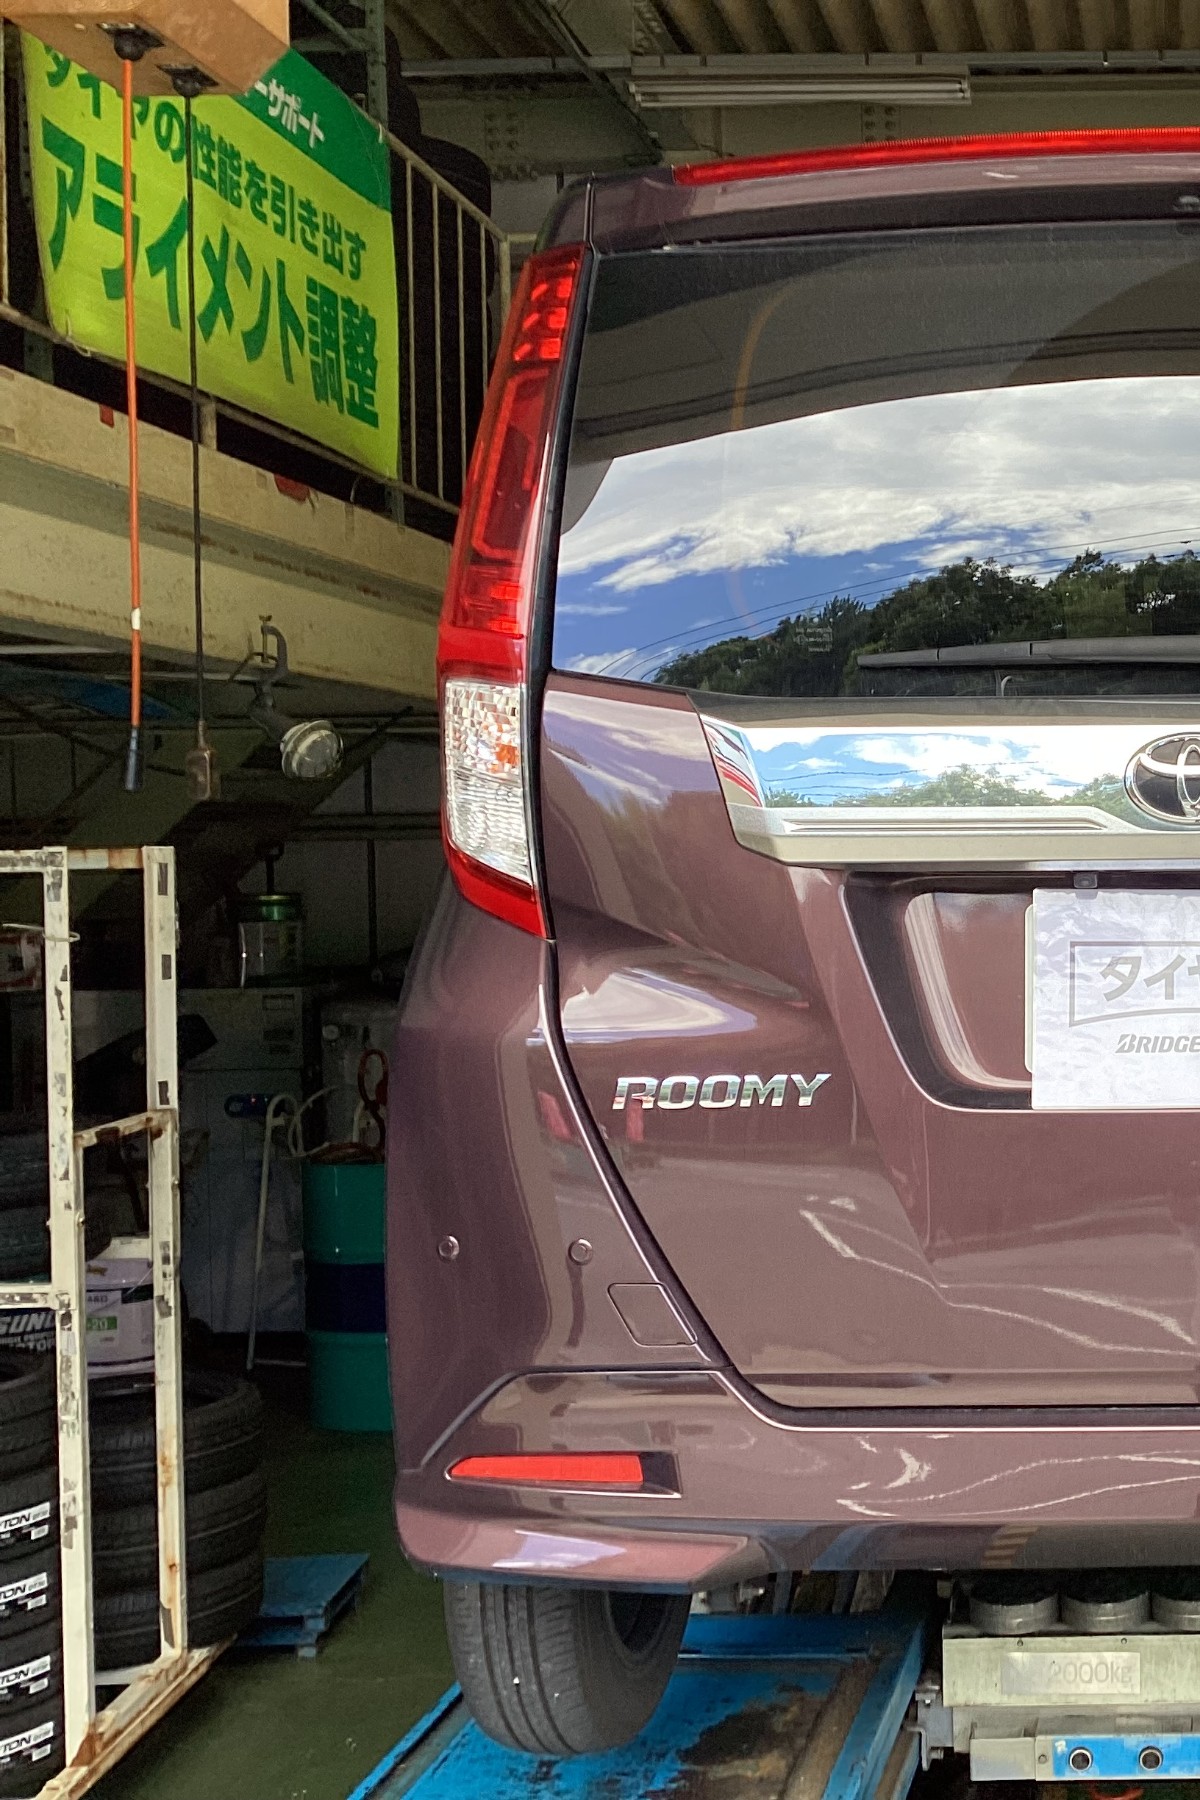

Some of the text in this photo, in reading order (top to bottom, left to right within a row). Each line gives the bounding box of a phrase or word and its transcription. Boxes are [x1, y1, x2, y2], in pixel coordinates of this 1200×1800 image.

[41, 115, 379, 429] アライメント調整
[612, 1073, 832, 1110] ROOMY
